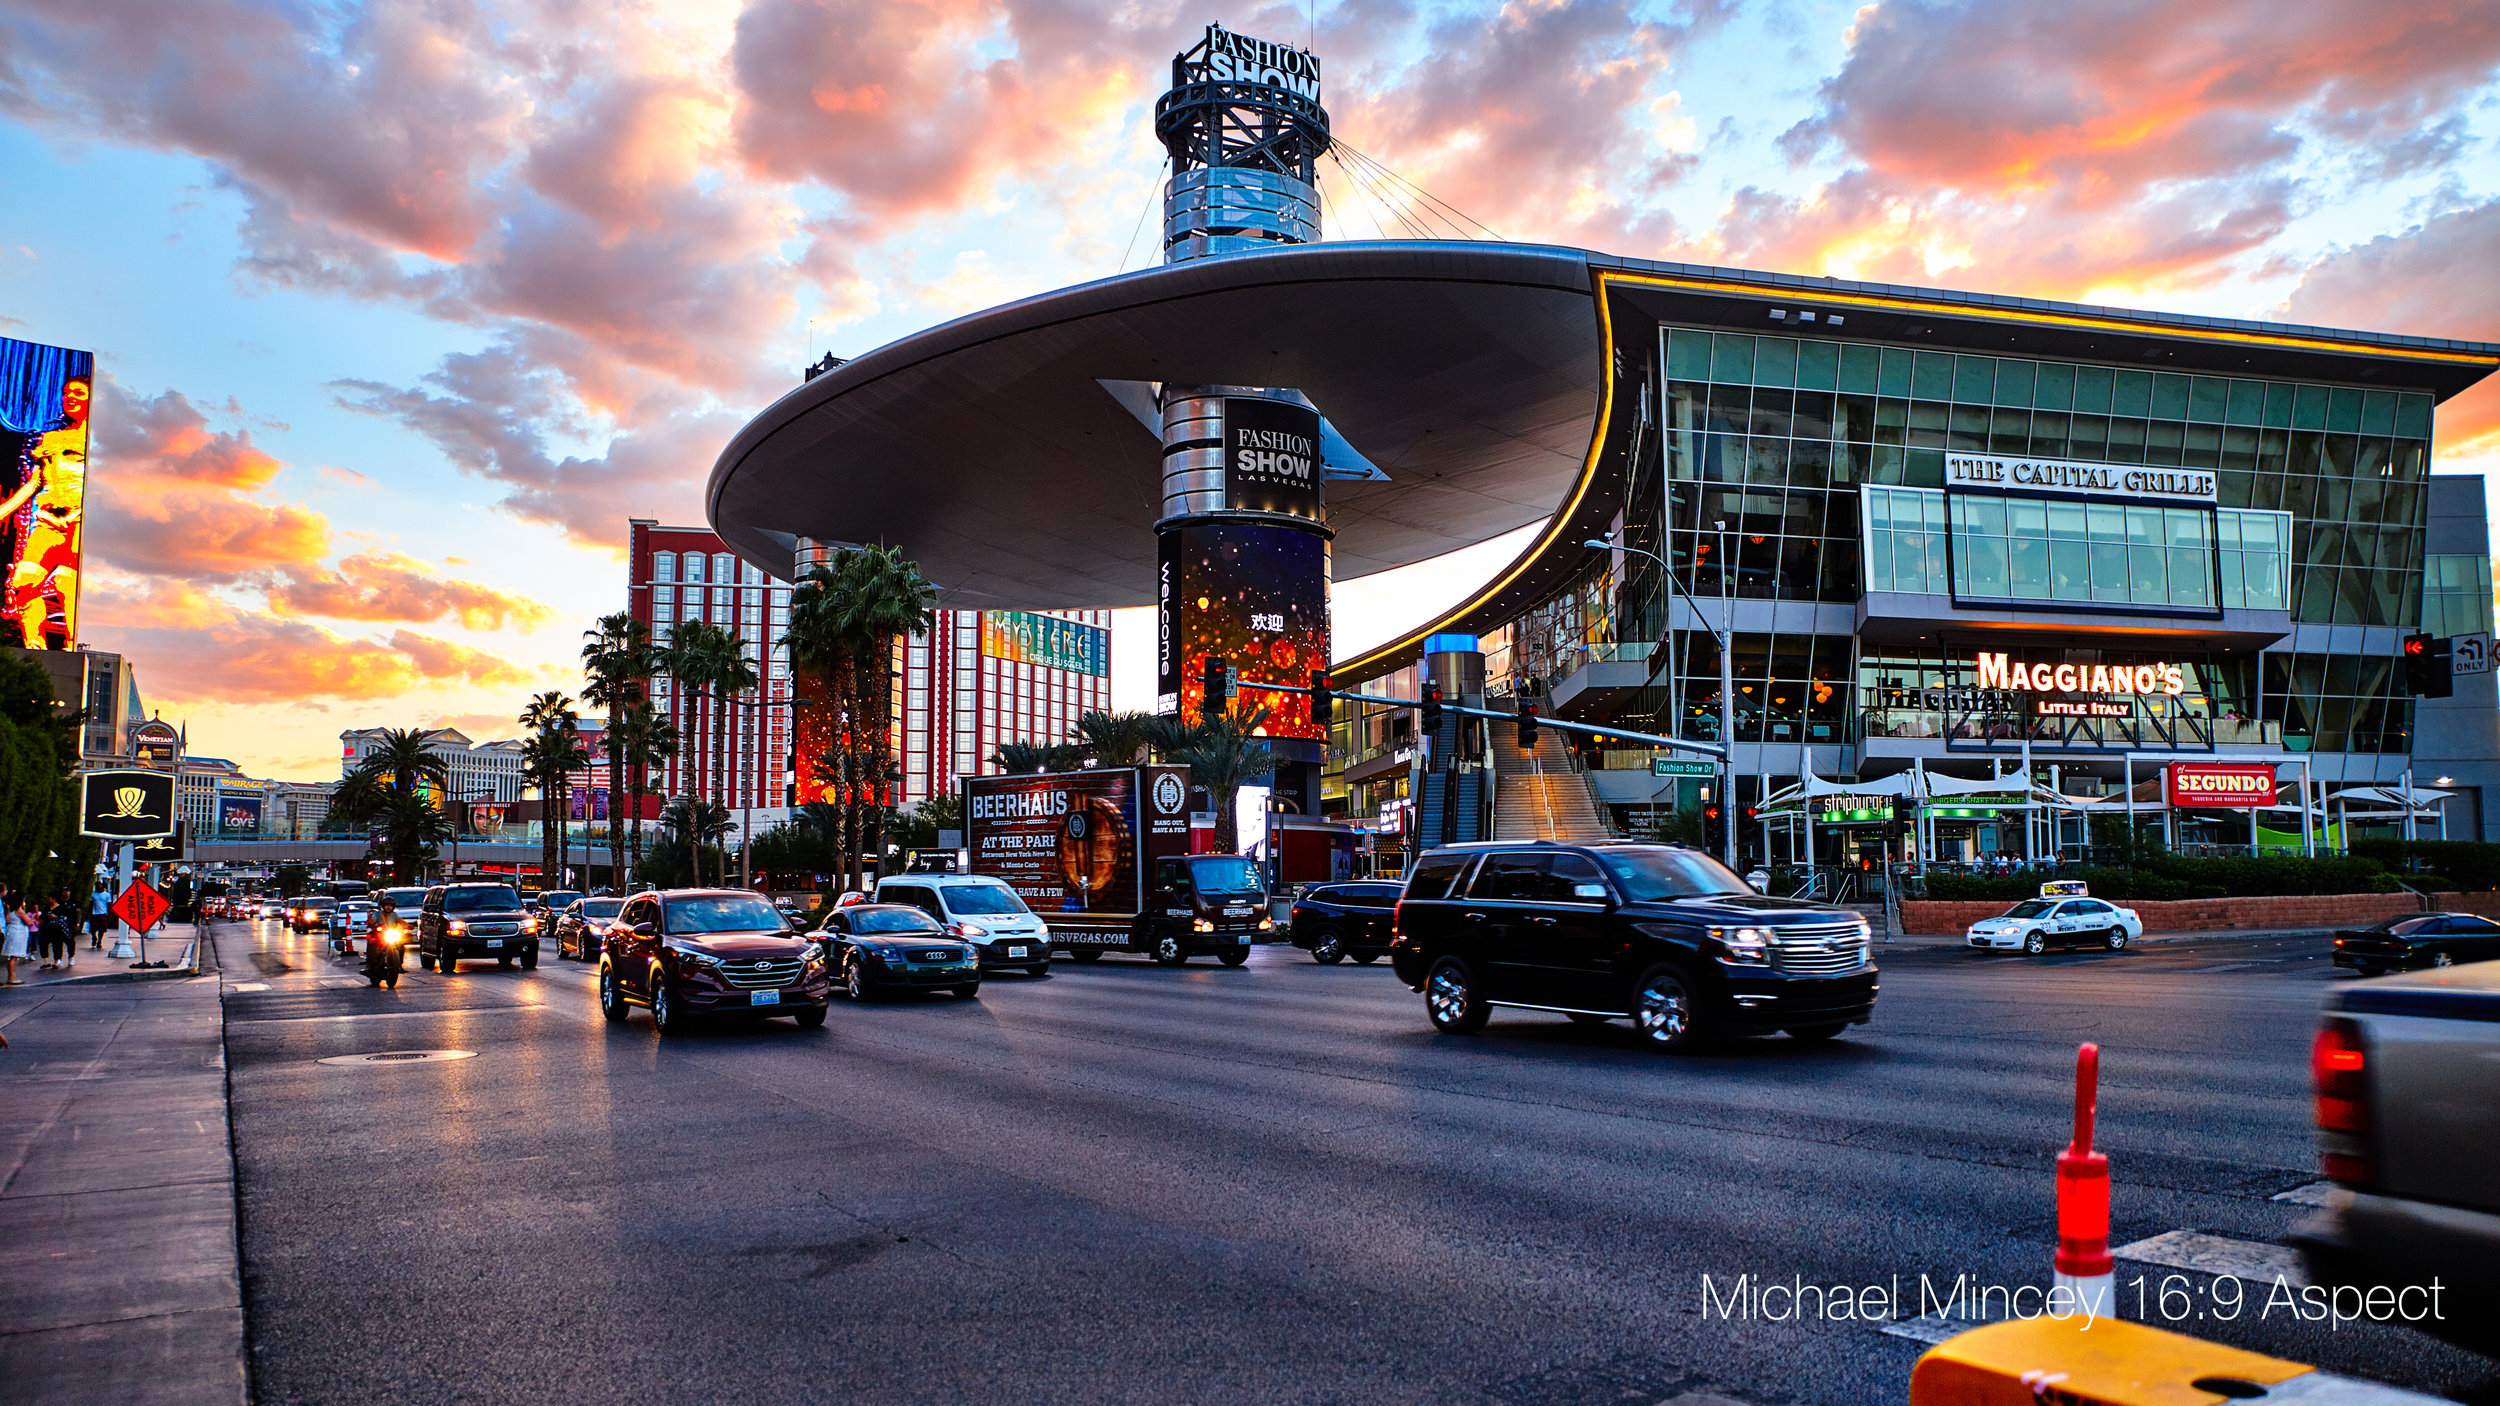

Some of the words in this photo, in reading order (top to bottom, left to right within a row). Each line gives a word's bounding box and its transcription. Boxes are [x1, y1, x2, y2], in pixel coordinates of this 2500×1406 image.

[1209, 27, 1319, 81] FASHION
[1209, 52, 1320, 102] SHOW
[1237, 428, 1312, 457] FASHION
[1237, 449, 1311, 479] SHOW
[1238, 474, 1267, 483] LAS
[1273, 476, 1312, 490] VEGAS
[1952, 459, 2005, 481] THE
[2013, 463, 2118, 490] CAPITAL
[2124, 471, 2215, 496] GRILLE
[1250, 613, 1285, 632] 欢迎
[1029, 653, 1053, 666] CIRQUE
[1053, 656, 1063, 666] DU
[1063, 659, 1084, 671] SOLEIL
[2456, 661, 2484, 672] ONLY
[1978, 651, 2185, 695] MAGGIANO'S
[2038, 701, 2088, 715] LITTLE
[2091, 702, 2129, 716] ITALY
[1658, 763, 1684, 773] Fashion
[1685, 763, 1703, 773] Show
[1704, 764, 1712, 774] Dr
[2177, 775, 2270, 792] SEGUNDO
[972, 791, 1068, 818] BEERHAUS
[225, 817, 256, 828] LOVE
[982, 836, 998, 849] AT
[999, 835, 1024, 848] THE
[1019, 887, 1039, 896] HAVE
[1039, 887, 1046, 896] A
[1046, 887, 1063, 896] FEW
[127, 895, 136, 919] AHEAD
[147, 895, 155, 915] ROAD
[1166, 908, 1194, 916] BEERHAUS
[1223, 908, 1254, 916] BEERHAUS
